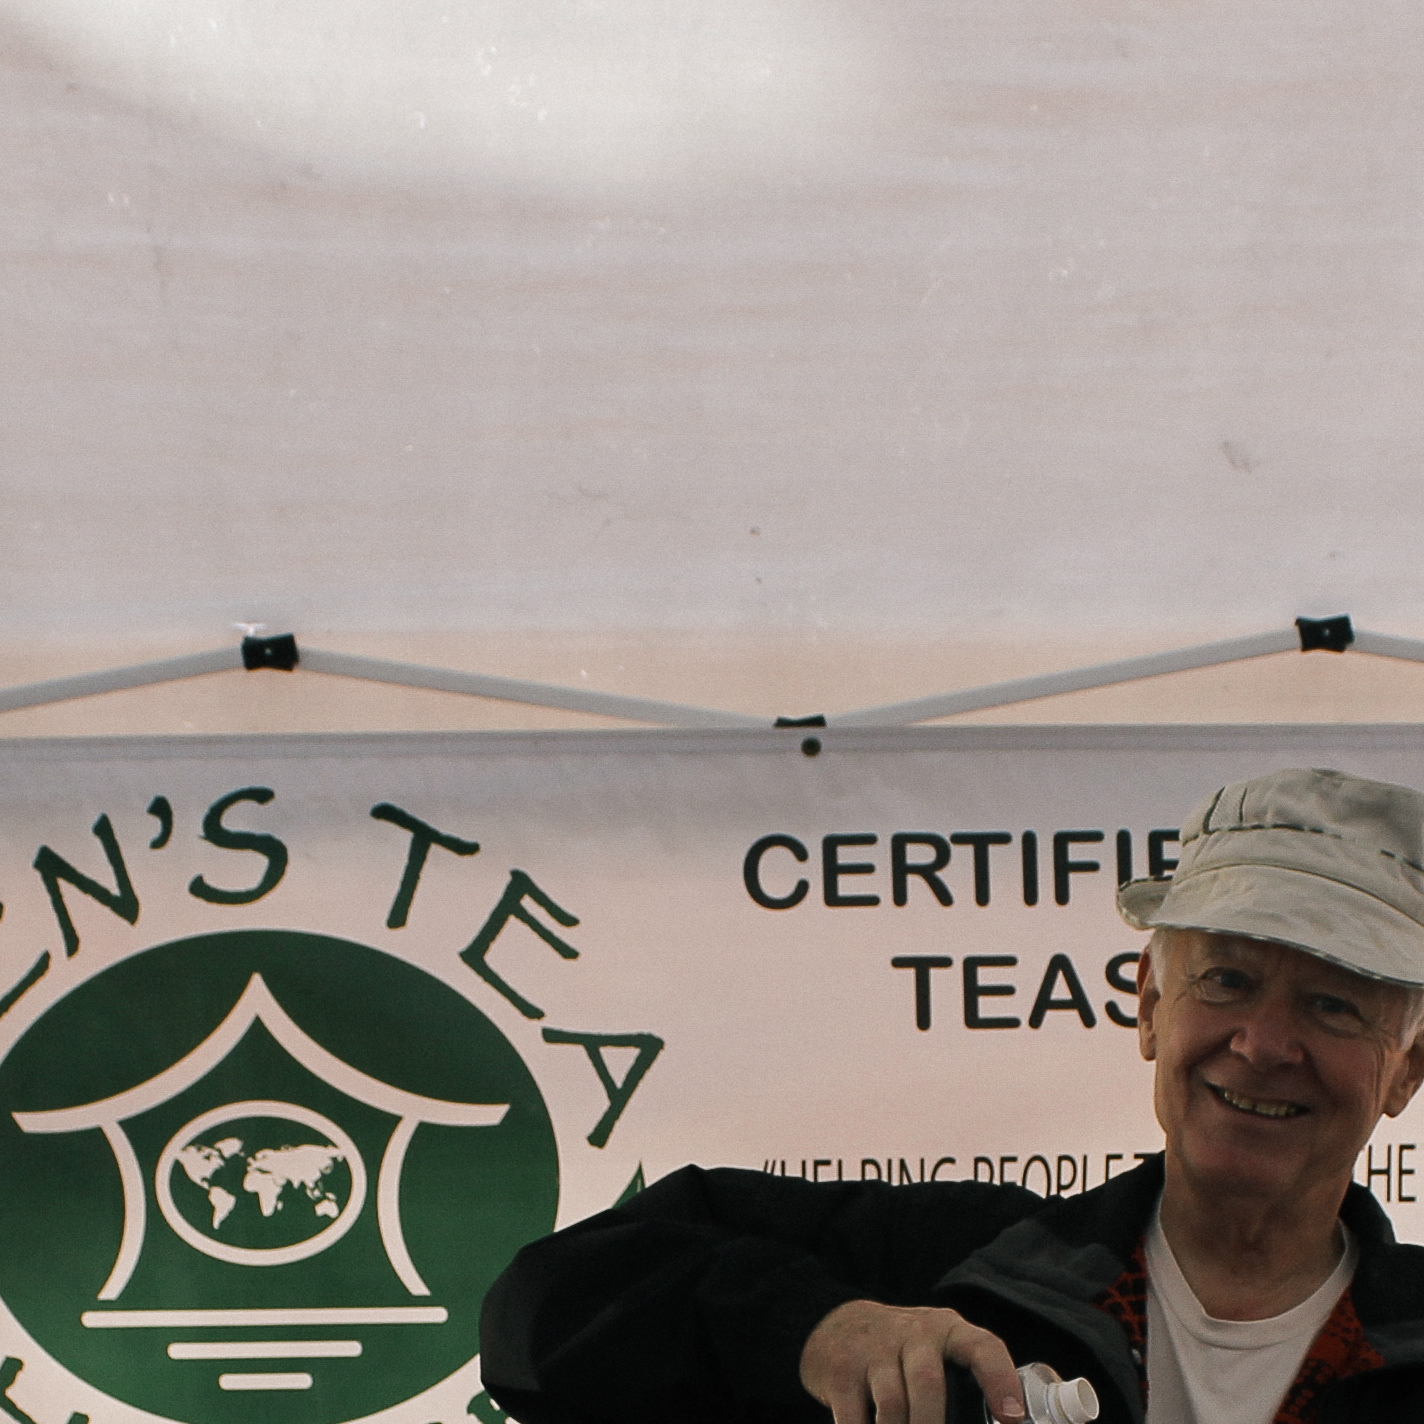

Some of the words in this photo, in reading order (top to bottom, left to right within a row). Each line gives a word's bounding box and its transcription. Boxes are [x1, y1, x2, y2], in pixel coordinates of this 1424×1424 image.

[743, 829, 1182, 909] CERTIFI
[371, 801, 664, 1150] TEA
[1366, 1142, 1416, 1202] HE
